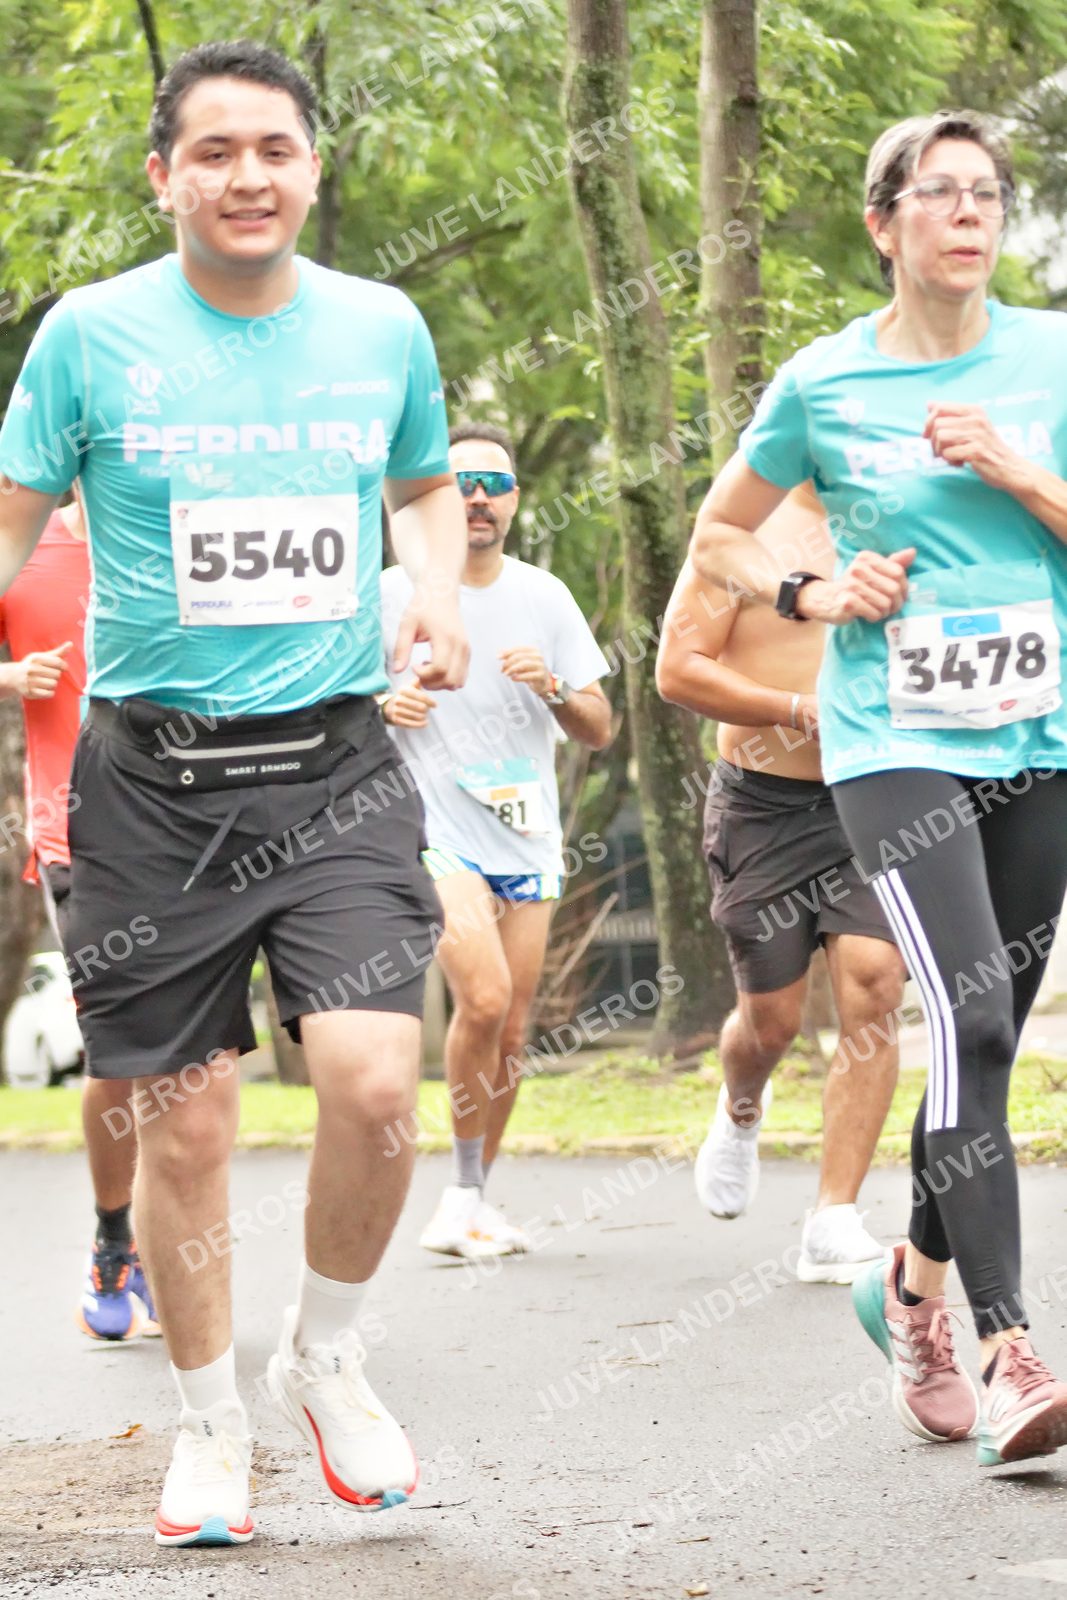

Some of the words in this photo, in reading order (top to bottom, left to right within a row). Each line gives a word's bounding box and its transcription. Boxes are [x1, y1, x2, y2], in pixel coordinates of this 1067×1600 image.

[187, 526, 346, 583] 5540
[899, 631, 1047, 694] 3478
[225, 765, 256, 776] SMART
[260, 762, 301, 773] BAMBOO
